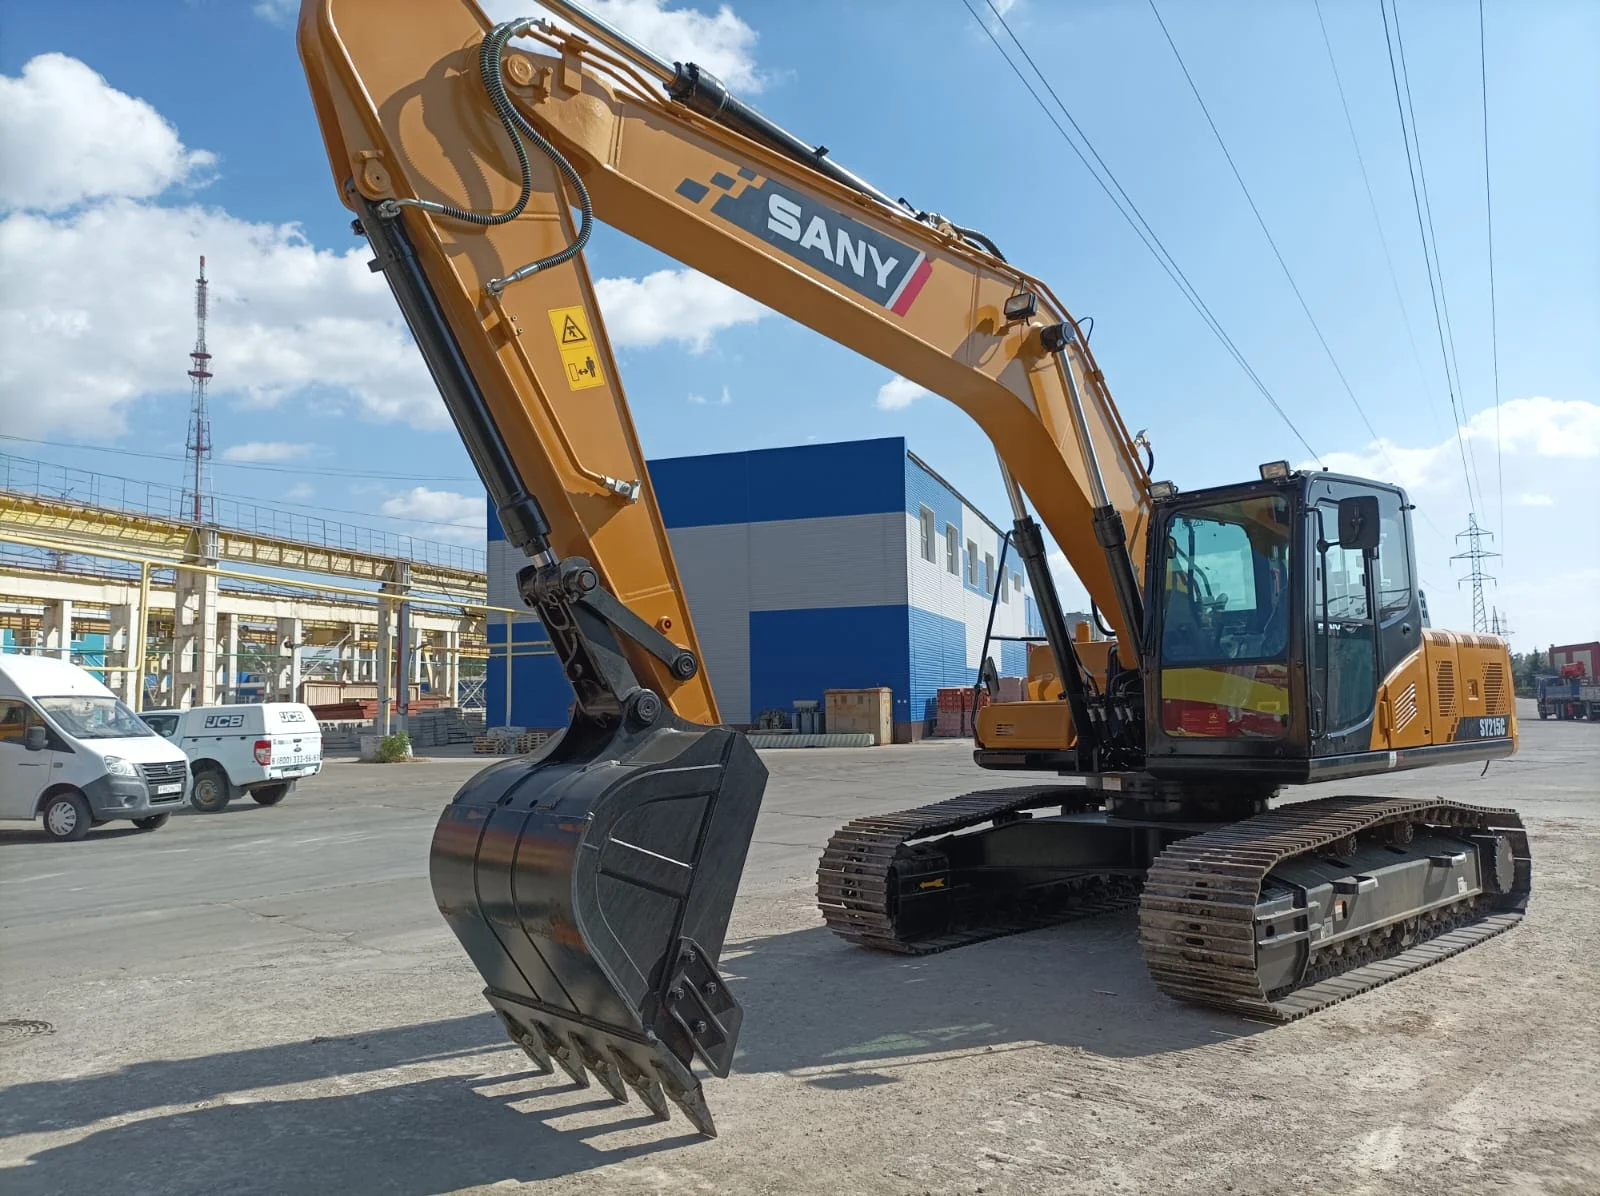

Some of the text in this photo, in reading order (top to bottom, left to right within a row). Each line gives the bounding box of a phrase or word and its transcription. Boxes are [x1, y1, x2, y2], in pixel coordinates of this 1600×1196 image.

[767, 193, 899, 288] SANY
[1317, 622, 1341, 636] SNY
[205, 715, 243, 728] JCB
[279, 711, 305, 722] JCB
[1480, 717, 1506, 737] SY215C
